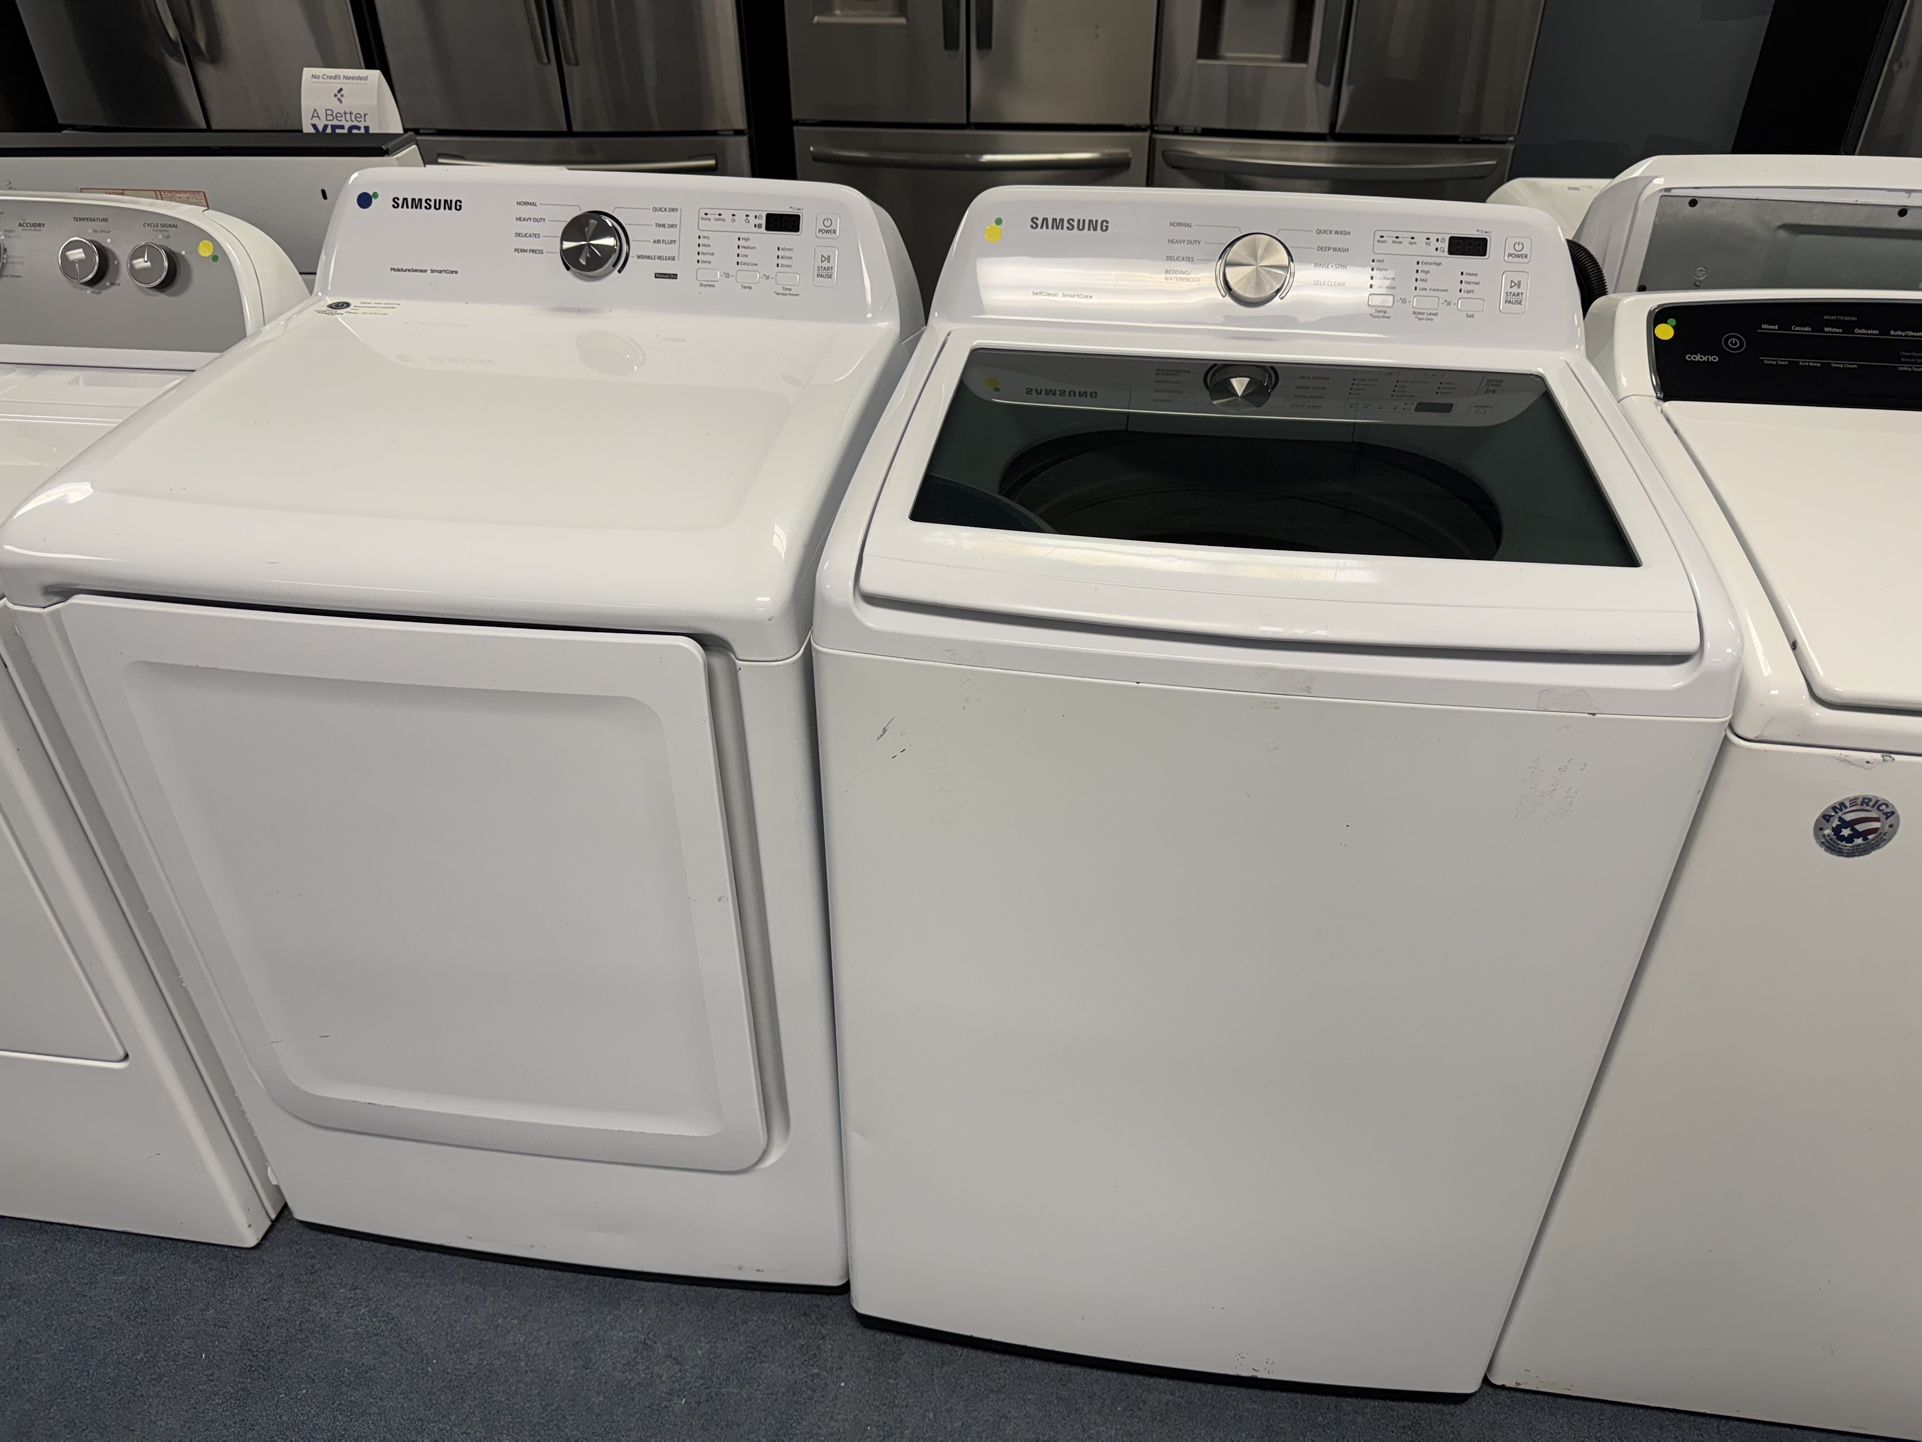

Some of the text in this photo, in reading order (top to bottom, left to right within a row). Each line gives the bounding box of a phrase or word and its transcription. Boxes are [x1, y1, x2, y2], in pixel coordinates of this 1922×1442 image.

[311, 109, 368, 122] A Better
[392, 197, 463, 211] SAMSUNG
[1030, 216, 1110, 232] SAMSUNG
[1686, 353, 1719, 362] cabrio
[1822, 797, 1896, 823] AMERICA
